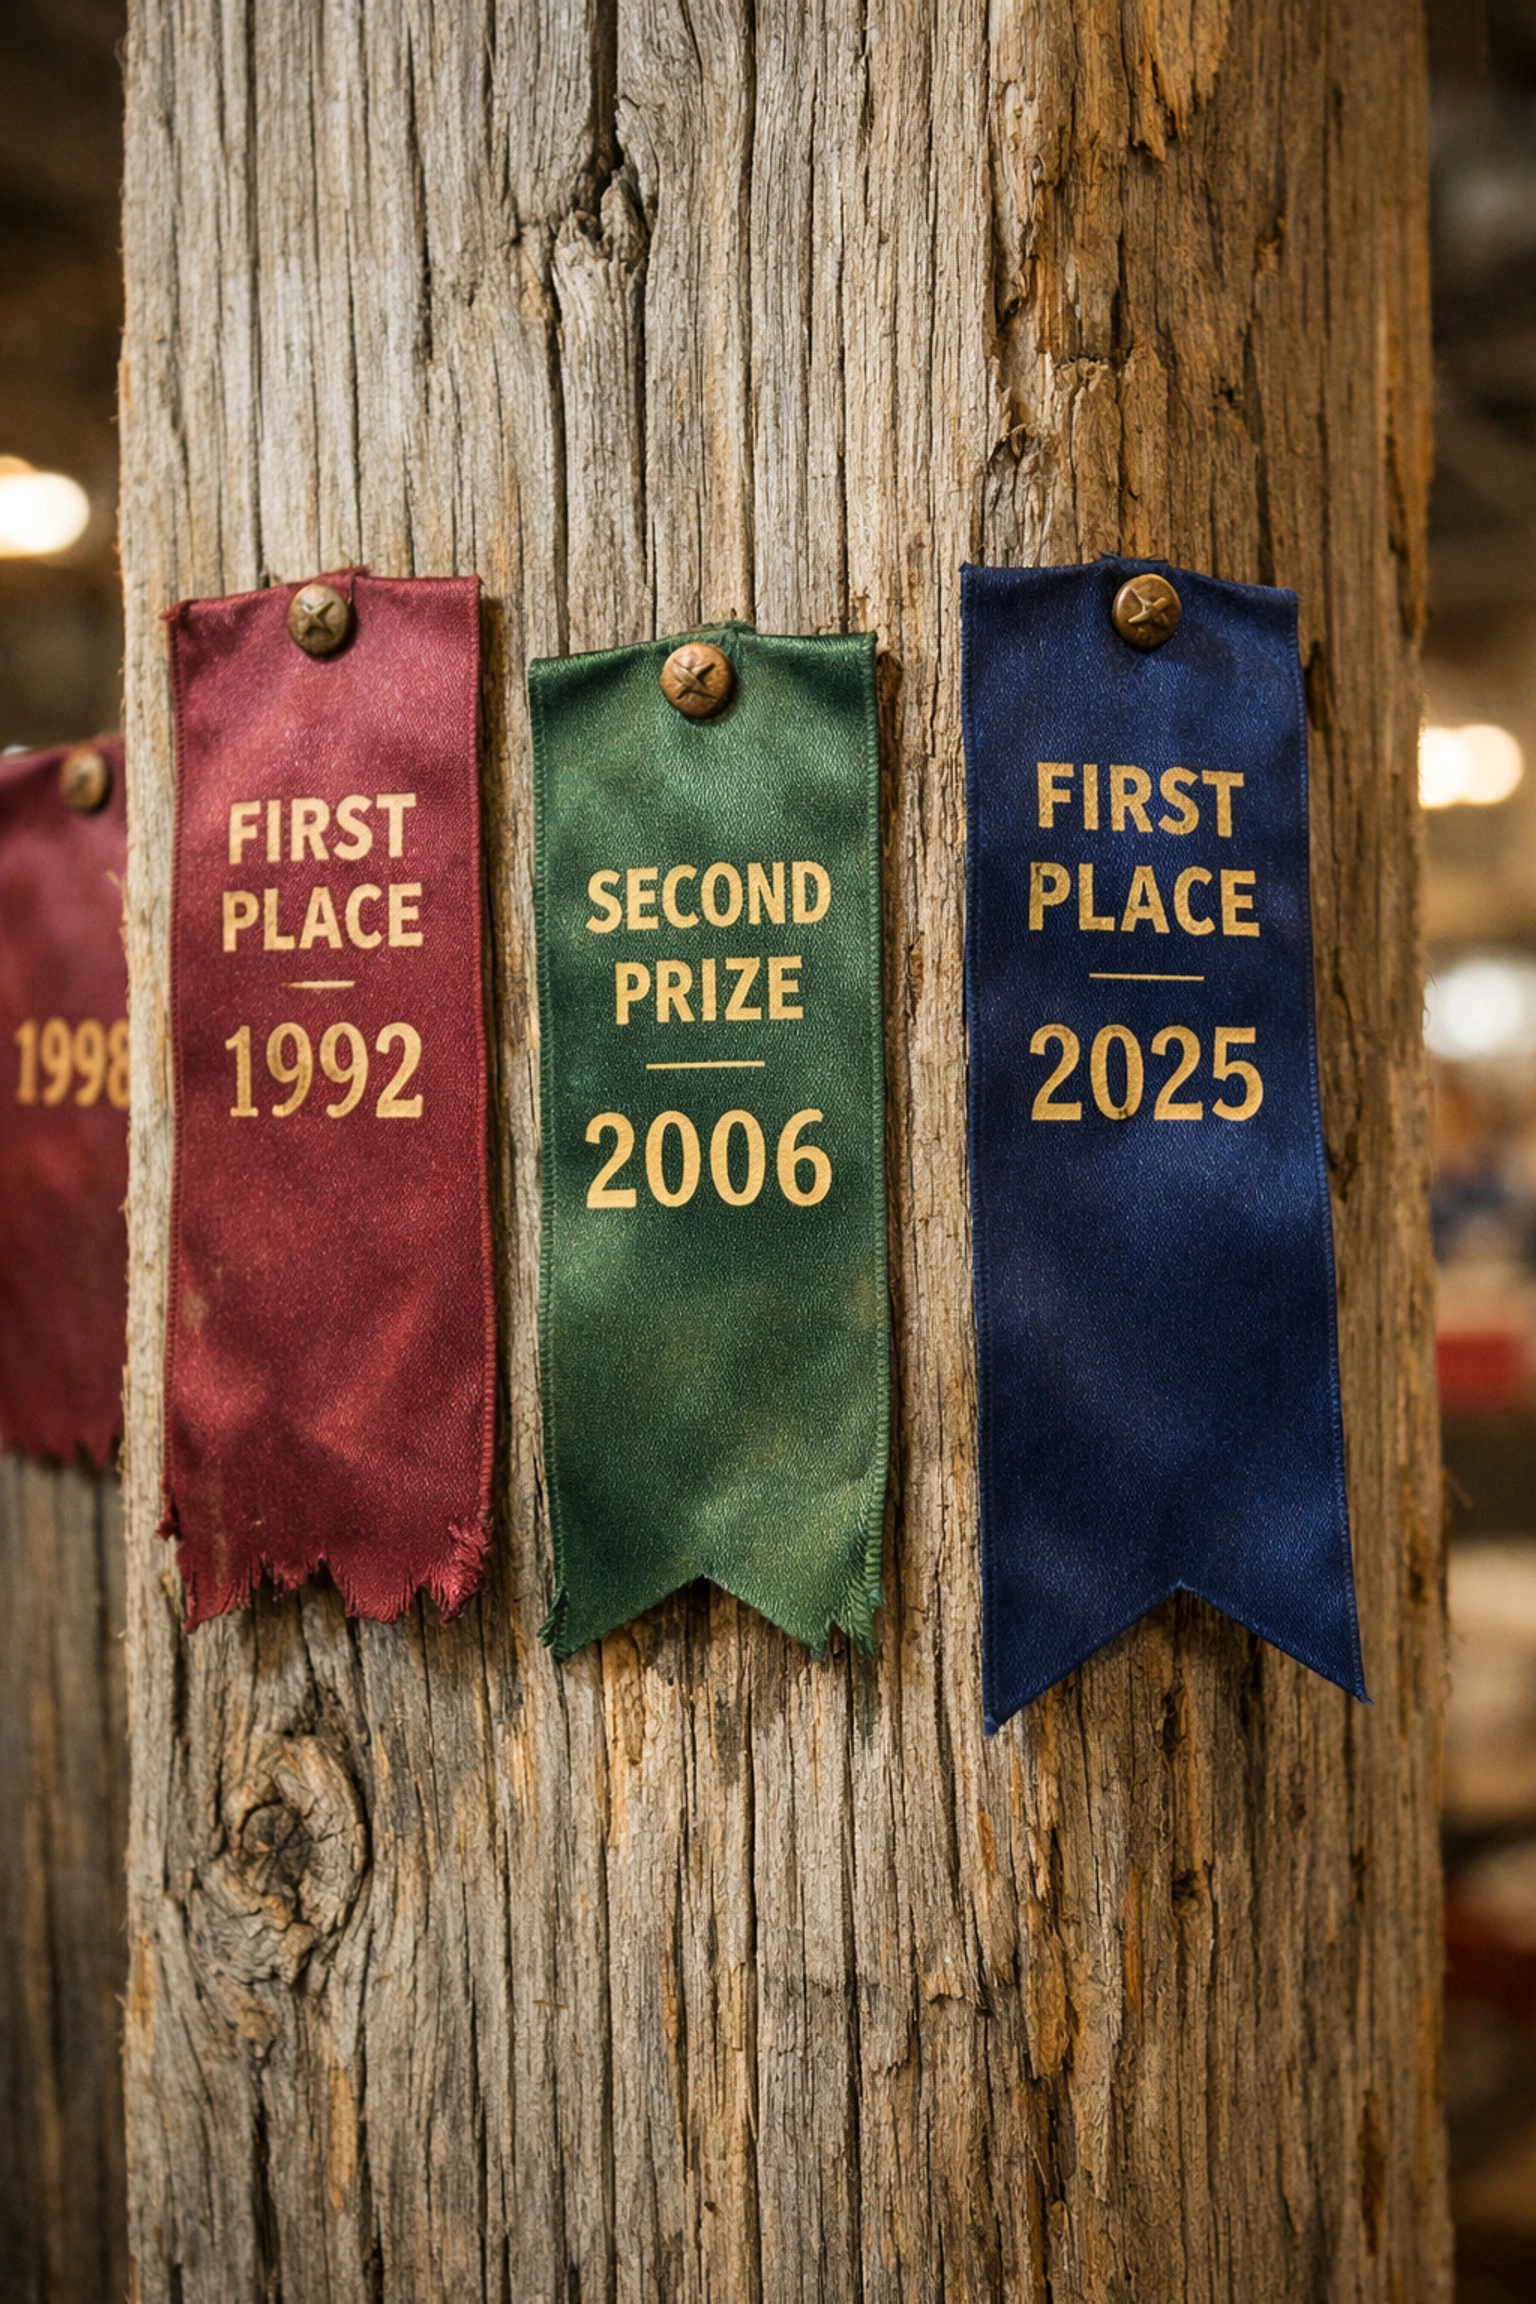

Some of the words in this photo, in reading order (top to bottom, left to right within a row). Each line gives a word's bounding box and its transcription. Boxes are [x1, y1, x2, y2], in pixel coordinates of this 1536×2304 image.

[229, 793, 416, 864] FIRST
[1038, 763, 1243, 837] FIRST
[223, 882, 423, 951] PLACE
[586, 861, 831, 934] SECOND
[1030, 863, 1259, 936] PLACE
[616, 956, 803, 1025] PRIZE
[226, 1022, 423, 1118] 1992
[1030, 1025, 1263, 1121] 2025
[586, 1109, 831, 1209] 2006
